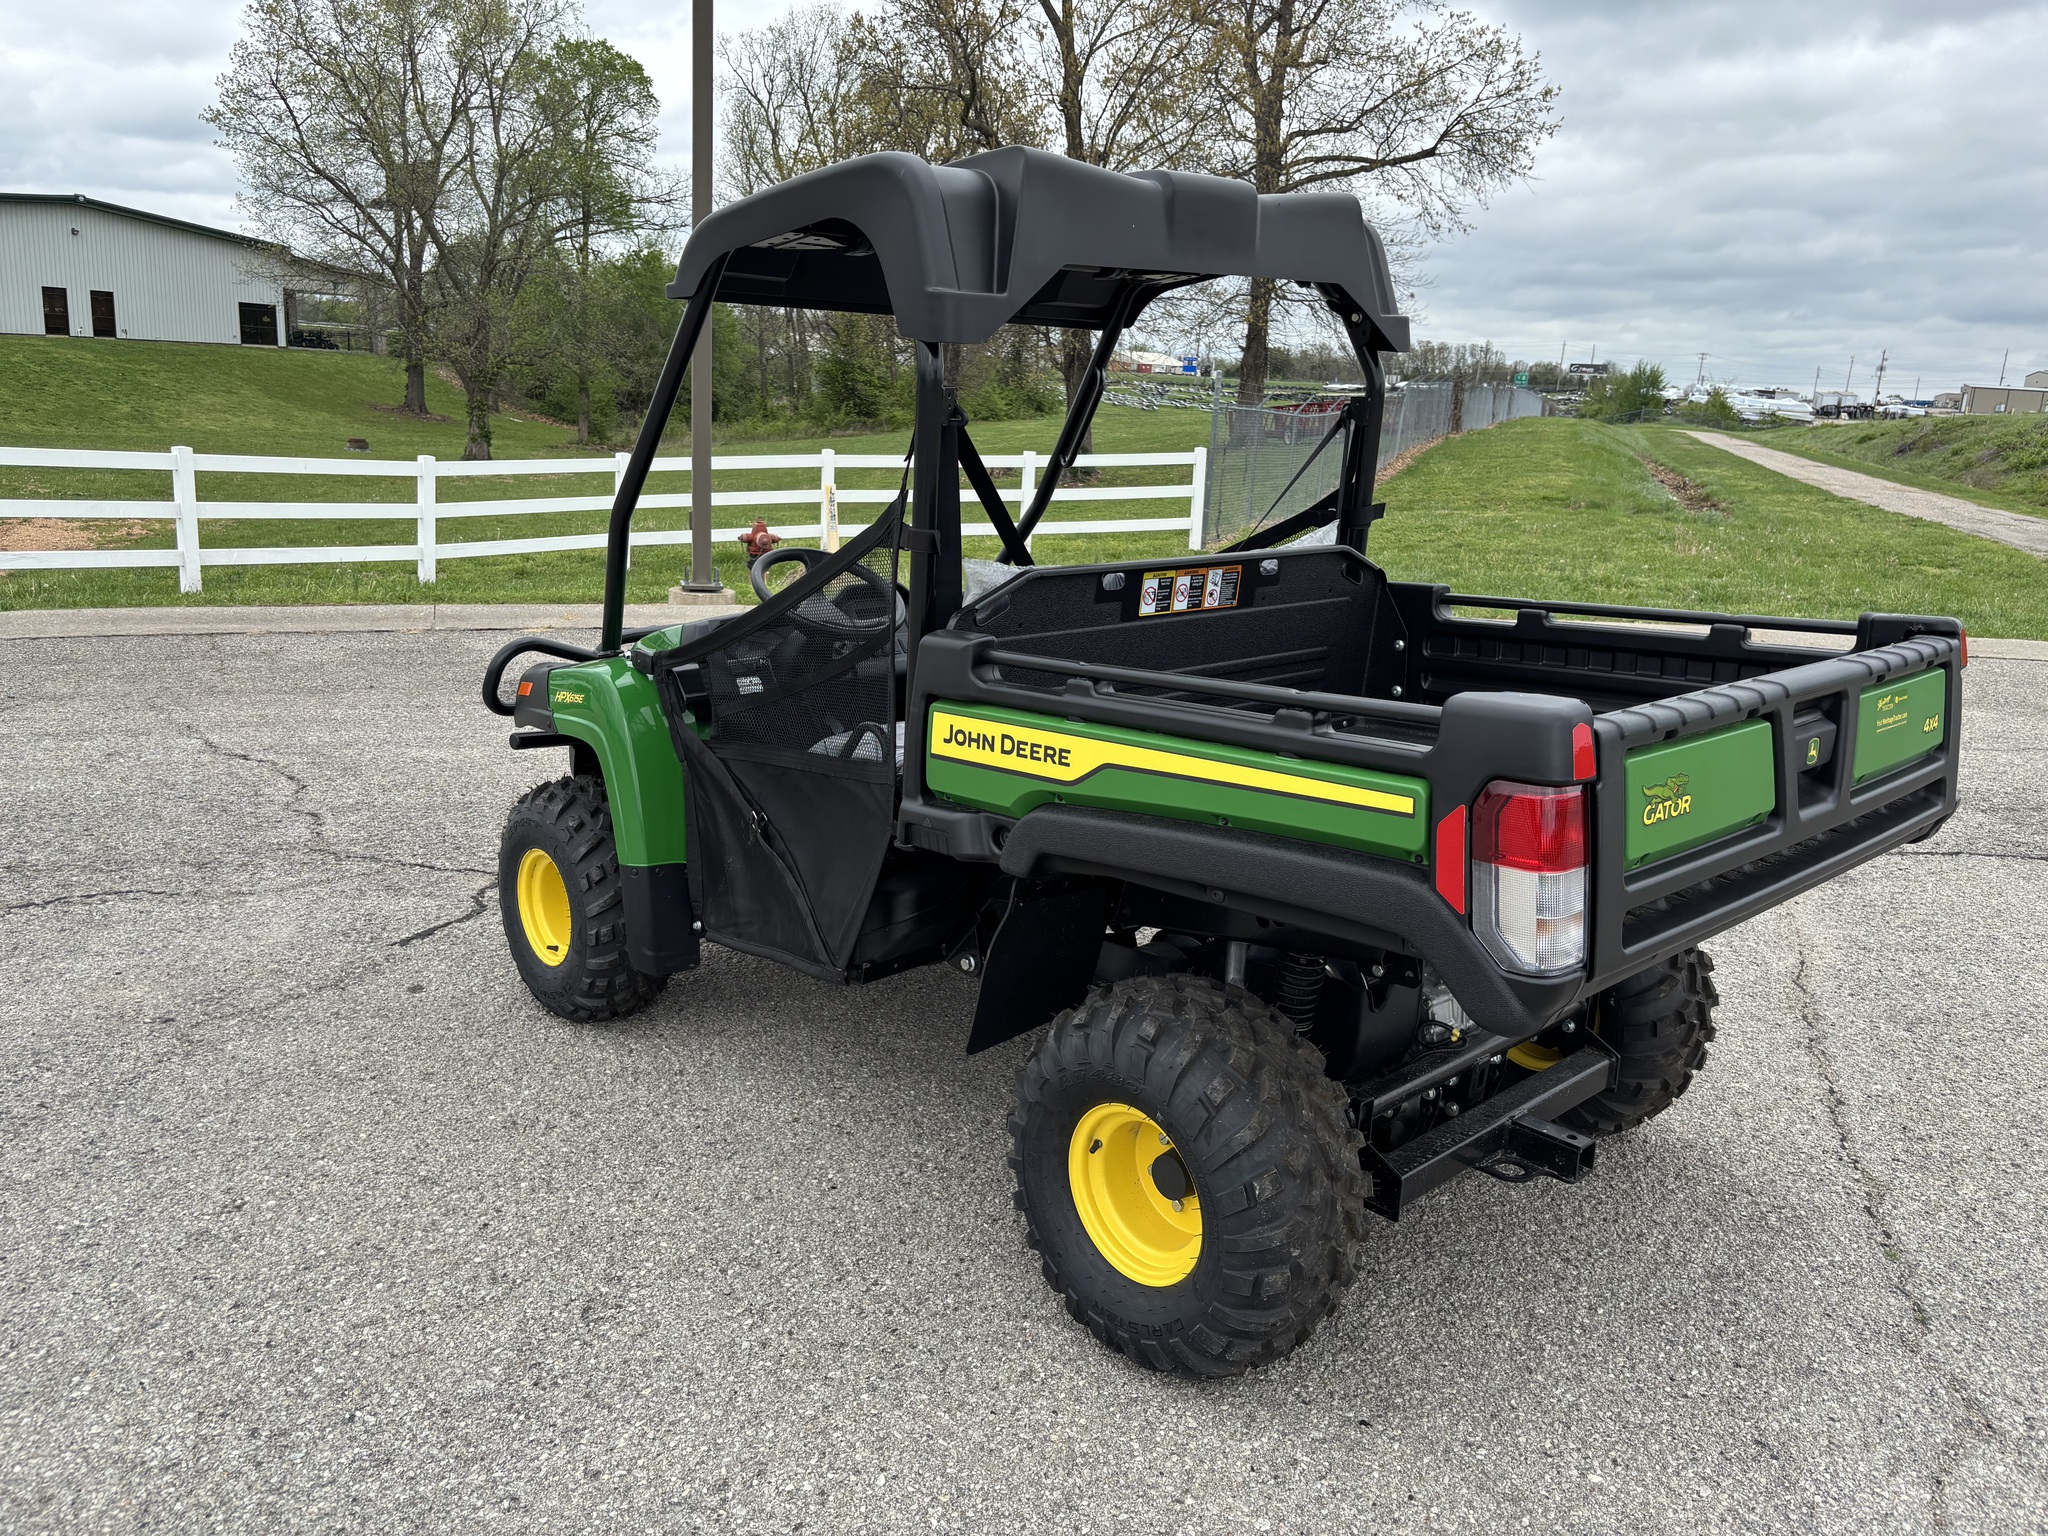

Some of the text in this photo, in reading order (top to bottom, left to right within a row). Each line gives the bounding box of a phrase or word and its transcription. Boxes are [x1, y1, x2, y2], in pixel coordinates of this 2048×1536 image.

[554, 690, 585, 704] HPX615E
[943, 724, 1071, 767] JOHN DEERE
[1643, 795, 1692, 825] GATOR
[1057, 1066, 1142, 1095] AT489
